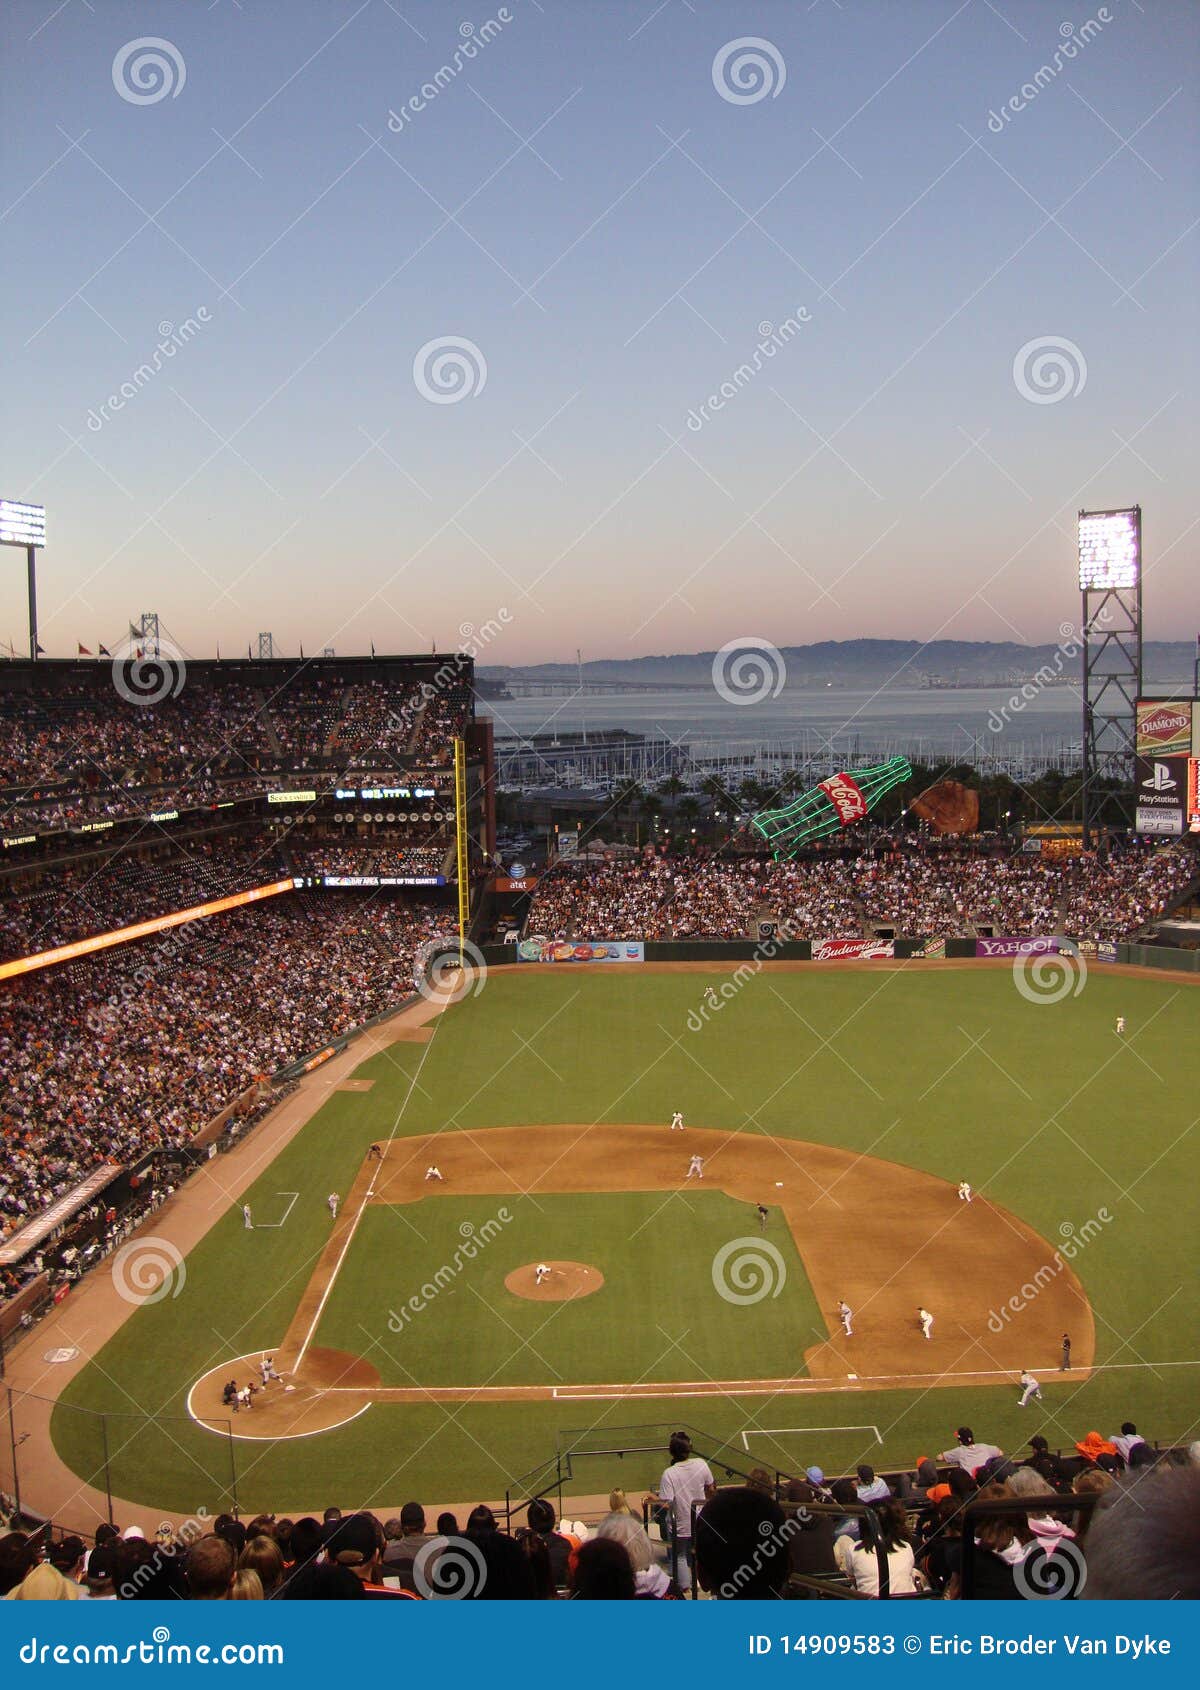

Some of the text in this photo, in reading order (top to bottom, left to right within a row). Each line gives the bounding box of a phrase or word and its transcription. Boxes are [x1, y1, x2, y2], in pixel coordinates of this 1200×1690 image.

[1141, 716, 1187, 734] DIAMOND
[1139, 794, 1179, 804] PlayStation
[817, 940, 884, 960] Budweiser
[980, 940, 1052, 955] YAHOO!
